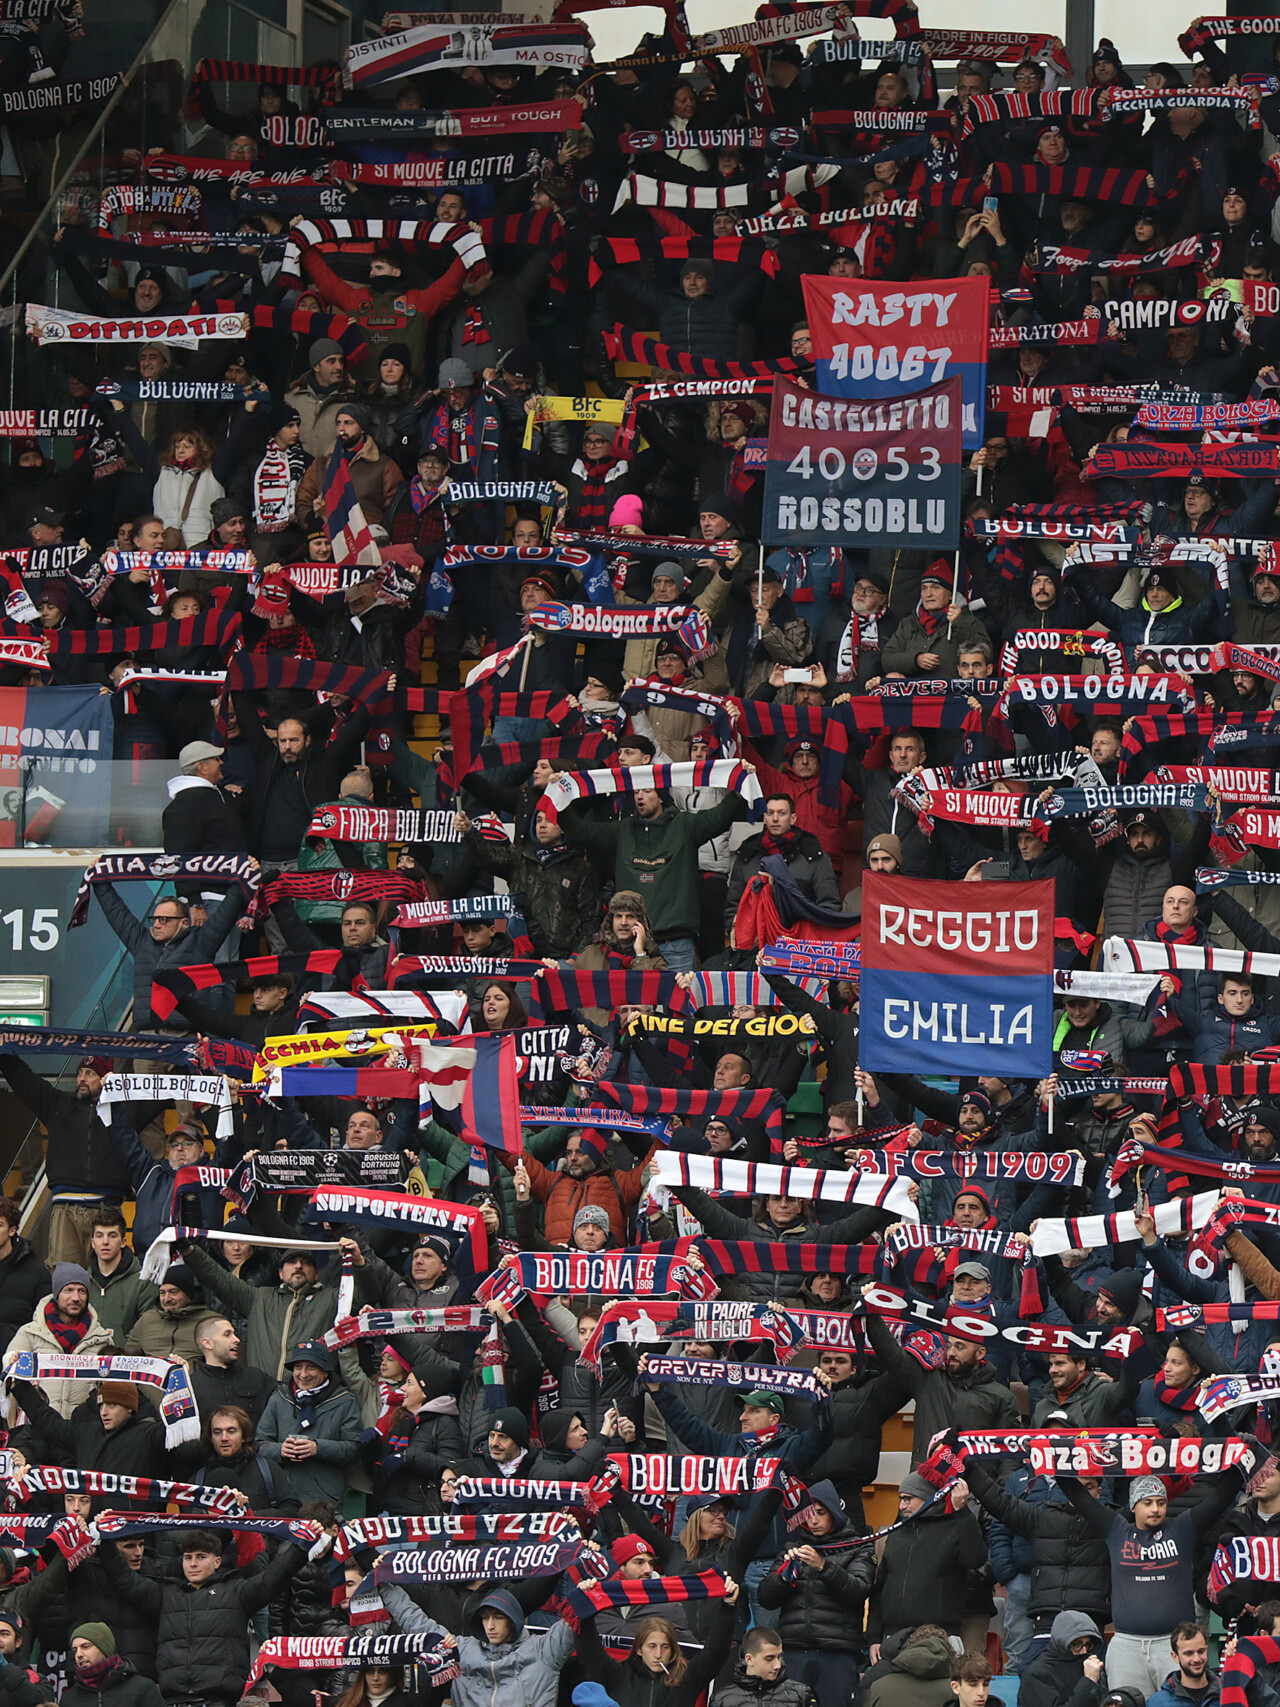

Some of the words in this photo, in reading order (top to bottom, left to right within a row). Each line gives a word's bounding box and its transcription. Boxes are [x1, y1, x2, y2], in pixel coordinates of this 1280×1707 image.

[925, 30, 967, 43] PADRE
[971, 32, 983, 42] IN
[986, 33, 1028, 44] FIGLIO
[1204, 21, 1233, 36] THE
[3, 86, 63, 112] BOLOGNA
[66, 84, 82, 103] FC
[88, 76, 119, 100] 1909
[326, 118, 415, 129] GENTLEMAN
[854, 111, 915, 130] BOLOGNA
[916, 112, 926, 124] FC
[193, 168, 222, 181] WE
[228, 169, 265, 185] ARE
[271, 169, 306, 183] ONE
[375, 164, 389, 179] SI
[393, 162, 444, 180] MUOVE
[448, 162, 467, 178] LA
[471, 153, 515, 176] CITTÀ
[320, 190, 346, 206] BFC
[831, 292, 957, 327] RASTY
[67, 316, 217, 339] DIFFIDATI
[990, 321, 1089, 342] MARATONA
[829, 343, 952, 383] 40067
[649, 383, 670, 400] ZE
[674, 379, 756, 397] CEMPION
[782, 393, 950, 432] CASTELLETTO
[778, 496, 945, 534] ROSSOBLU
[985, 519, 1127, 543] BOLOGNA
[444, 545, 591, 566] MODS
[290, 566, 338, 589] MUOVE
[341, 565, 360, 587] LA
[571, 605, 649, 638] Bologna
[1015, 632, 1060, 651] GOOD
[1018, 675, 1169, 702] BOLOGNA
[1085, 784, 1177, 809] BOLOGNA
[1180, 785, 1196, 798] FC
[946, 792, 964, 812] SI
[966, 793, 1018, 817] MUOVE
[1180, 798, 1195, 807] 1909
[1247, 814, 1262, 834] SI
[406, 900, 448, 918] MUOVE
[452, 899, 471, 913] LA
[473, 893, 510, 912] CITTÀ
[879, 904, 1039, 953] REGGIO
[694, 1017, 739, 1035] DEI
[883, 998, 1034, 1045] EMILIA
[259, 1153, 287, 1166] BOLOGNA
[289, 1155, 299, 1166] FC
[299, 1155, 315, 1166] 1909
[361, 1160, 400, 1169] DORTMUND
[363, 1153, 400, 1162] BORUSSIA
[856, 1150, 946, 1176] BFC
[985, 1151, 1073, 1183] 1909
[316, 1194, 445, 1229] SUPPORTERS
[535, 1259, 633, 1290] BOLOGNA
[637, 1259, 655, 1279] FC
[636, 1279, 653, 1290] 1909
[694, 1305, 708, 1321] DI
[712, 1303, 756, 1321] PADRE
[694, 1321, 707, 1338] IN
[710, 1319, 751, 1338] FIGLIO
[631, 1454, 749, 1493] BOLOGNA
[754, 1457, 777, 1477] FC
[752, 1478, 769, 1491] 1909
[392, 1548, 481, 1575] BOLOGNA
[486, 1547, 508, 1570] FC
[515, 1543, 558, 1568] 1909
[1120, 1540, 1179, 1561] EUFORIA
[422, 1573, 440, 1581] UEFA
[443, 1571, 492, 1580] CHAMPIONS
[495, 1569, 524, 1578] LEAGUE
[299, 1658, 314, 1667] ROMA
[315, 1658, 336, 1667] STADIO
[337, 1658, 361, 1666] OLIMPICO
[367, 1656, 390, 1665] 14.05.25
